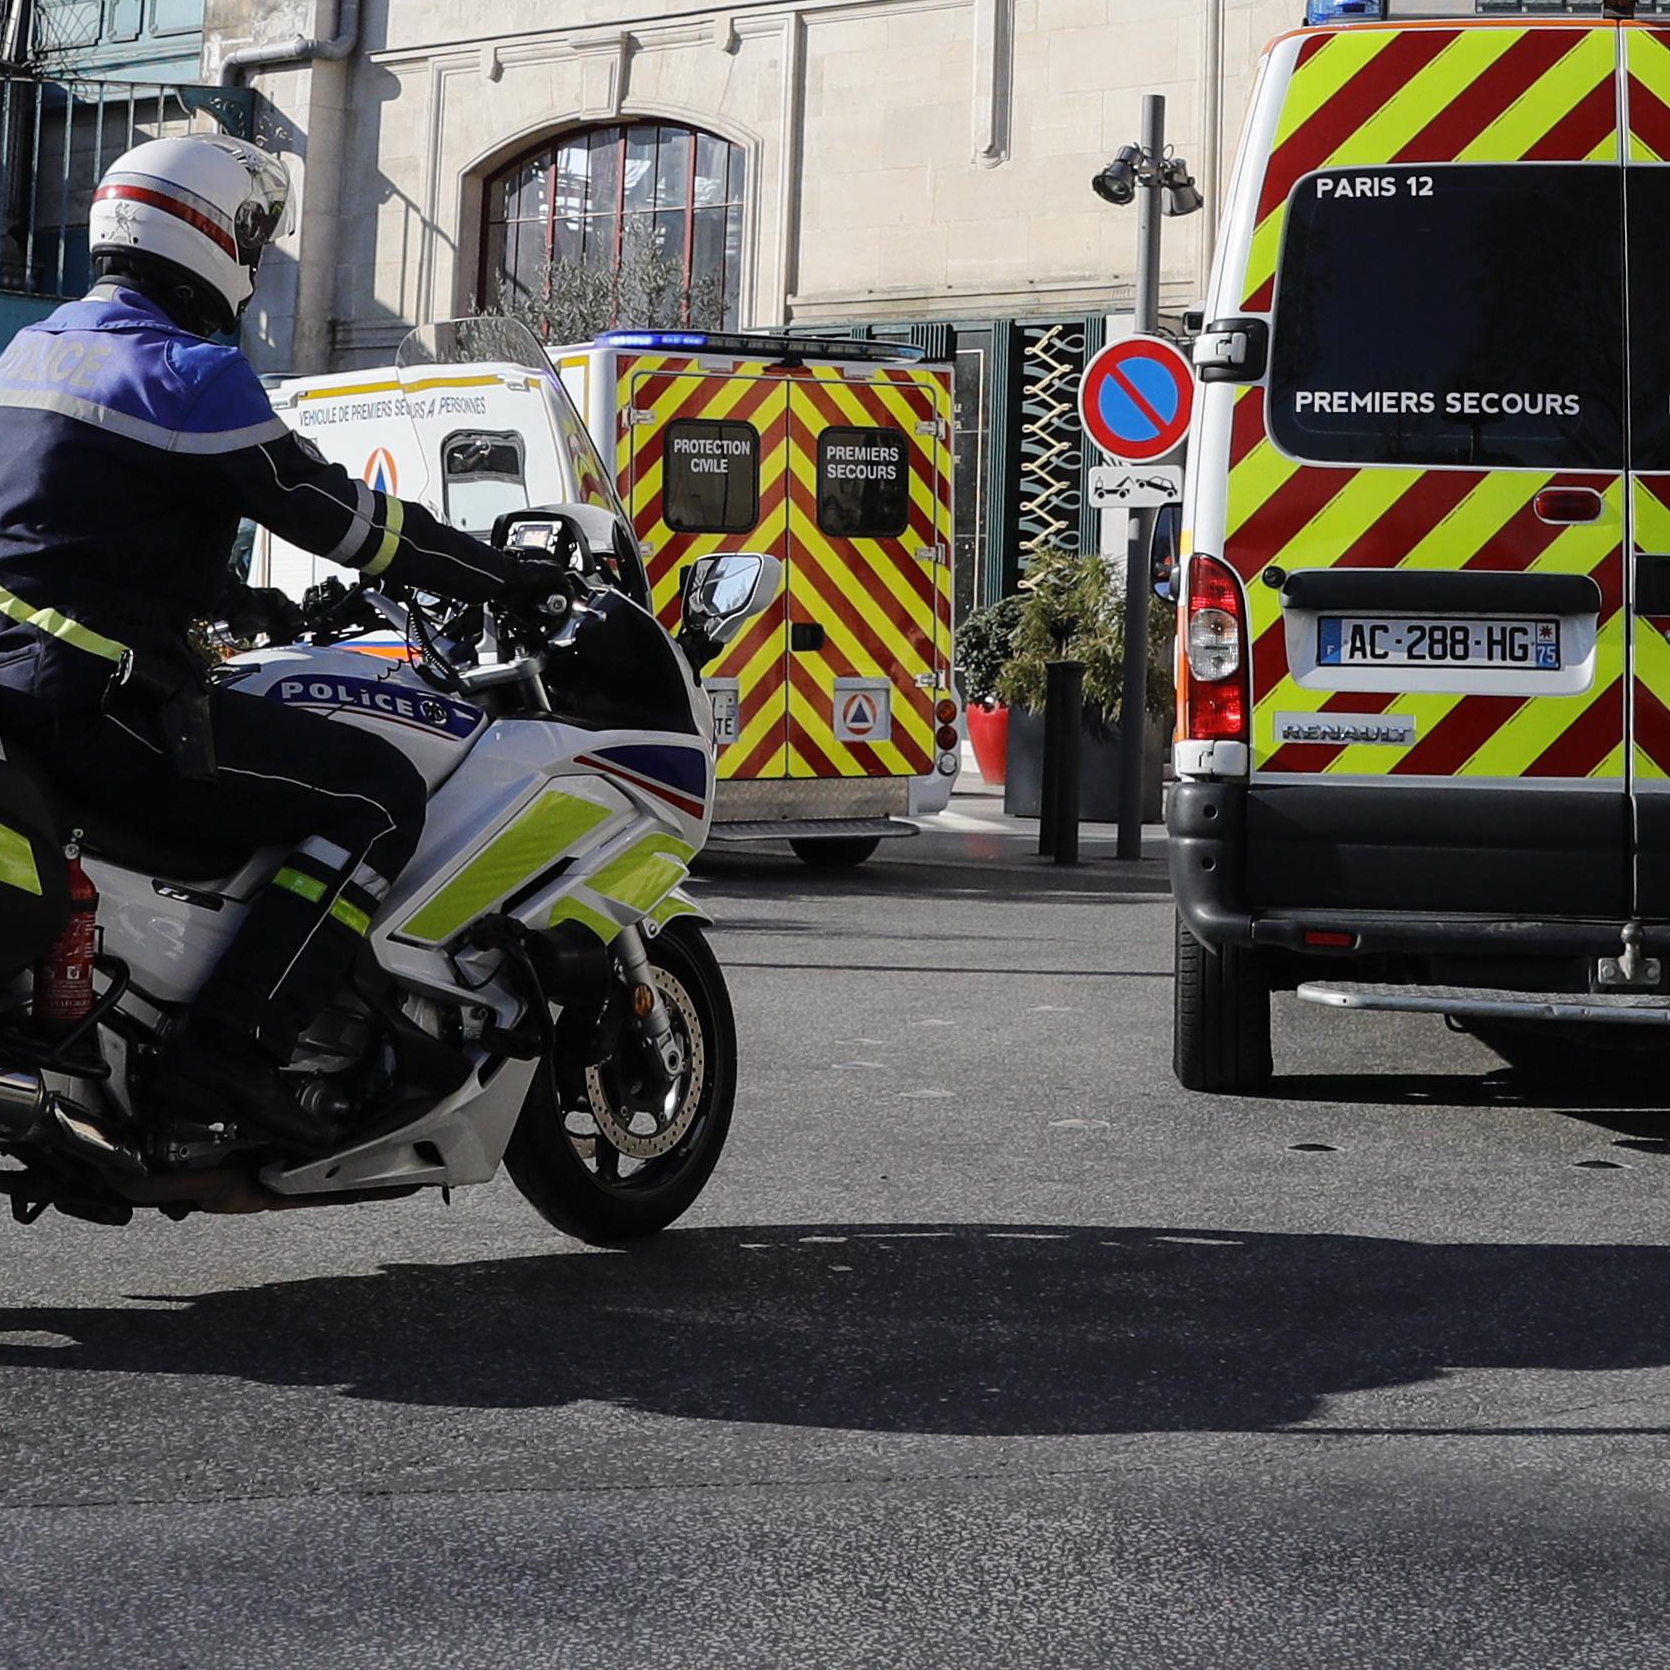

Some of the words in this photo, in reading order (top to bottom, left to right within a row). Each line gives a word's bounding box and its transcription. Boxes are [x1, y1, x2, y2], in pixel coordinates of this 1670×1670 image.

[1316, 177, 1396, 198] PARIS
[1407, 176, 1433, 196] 12
[1296, 391, 1435, 413] PREMIERS
[1445, 393, 1580, 415] SECOURS
[300, 406, 337, 426] VEHICULE
[339, 405, 349, 422] DE
[352, 400, 392, 420] PREMIERS
[674, 439, 750, 456] PROTECTION
[827, 446, 899, 462] PREMIERS
[691, 458, 728, 473] CIVILE
[827, 464, 897, 480] SECOURS
[1348, 624, 1529, 662] AC-288-HG
[1537, 646, 1556, 664] 75
[1282, 724, 1412, 743] RENAULT
